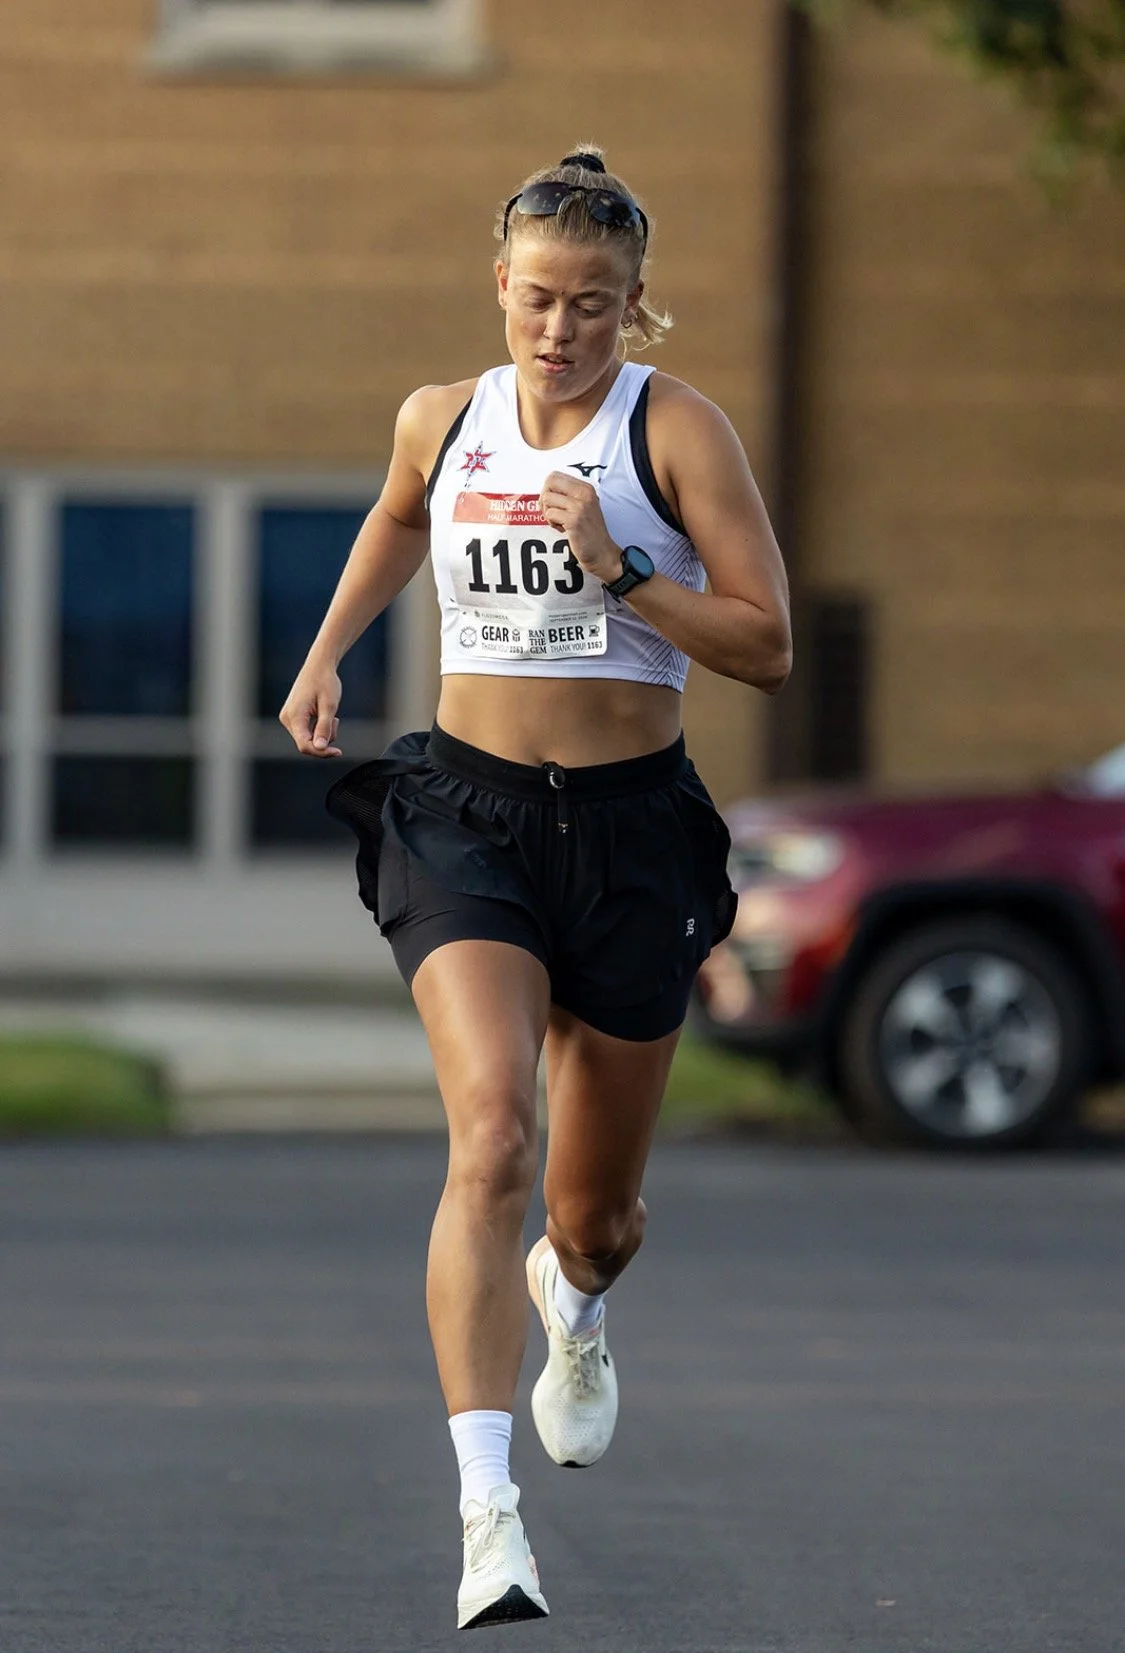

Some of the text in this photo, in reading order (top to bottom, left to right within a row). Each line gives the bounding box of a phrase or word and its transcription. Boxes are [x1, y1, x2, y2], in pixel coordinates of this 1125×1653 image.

[505, 513, 546, 522] MARATHO
[465, 538, 585, 596] 1163
[481, 625, 509, 643] GEAR
[528, 629, 545, 638] RAN
[548, 625, 585, 644] BEER
[529, 638, 547, 646] THE
[550, 643, 571, 653] THANK
[587, 640, 603, 650] 1163
[529, 646, 547, 654] GEM
